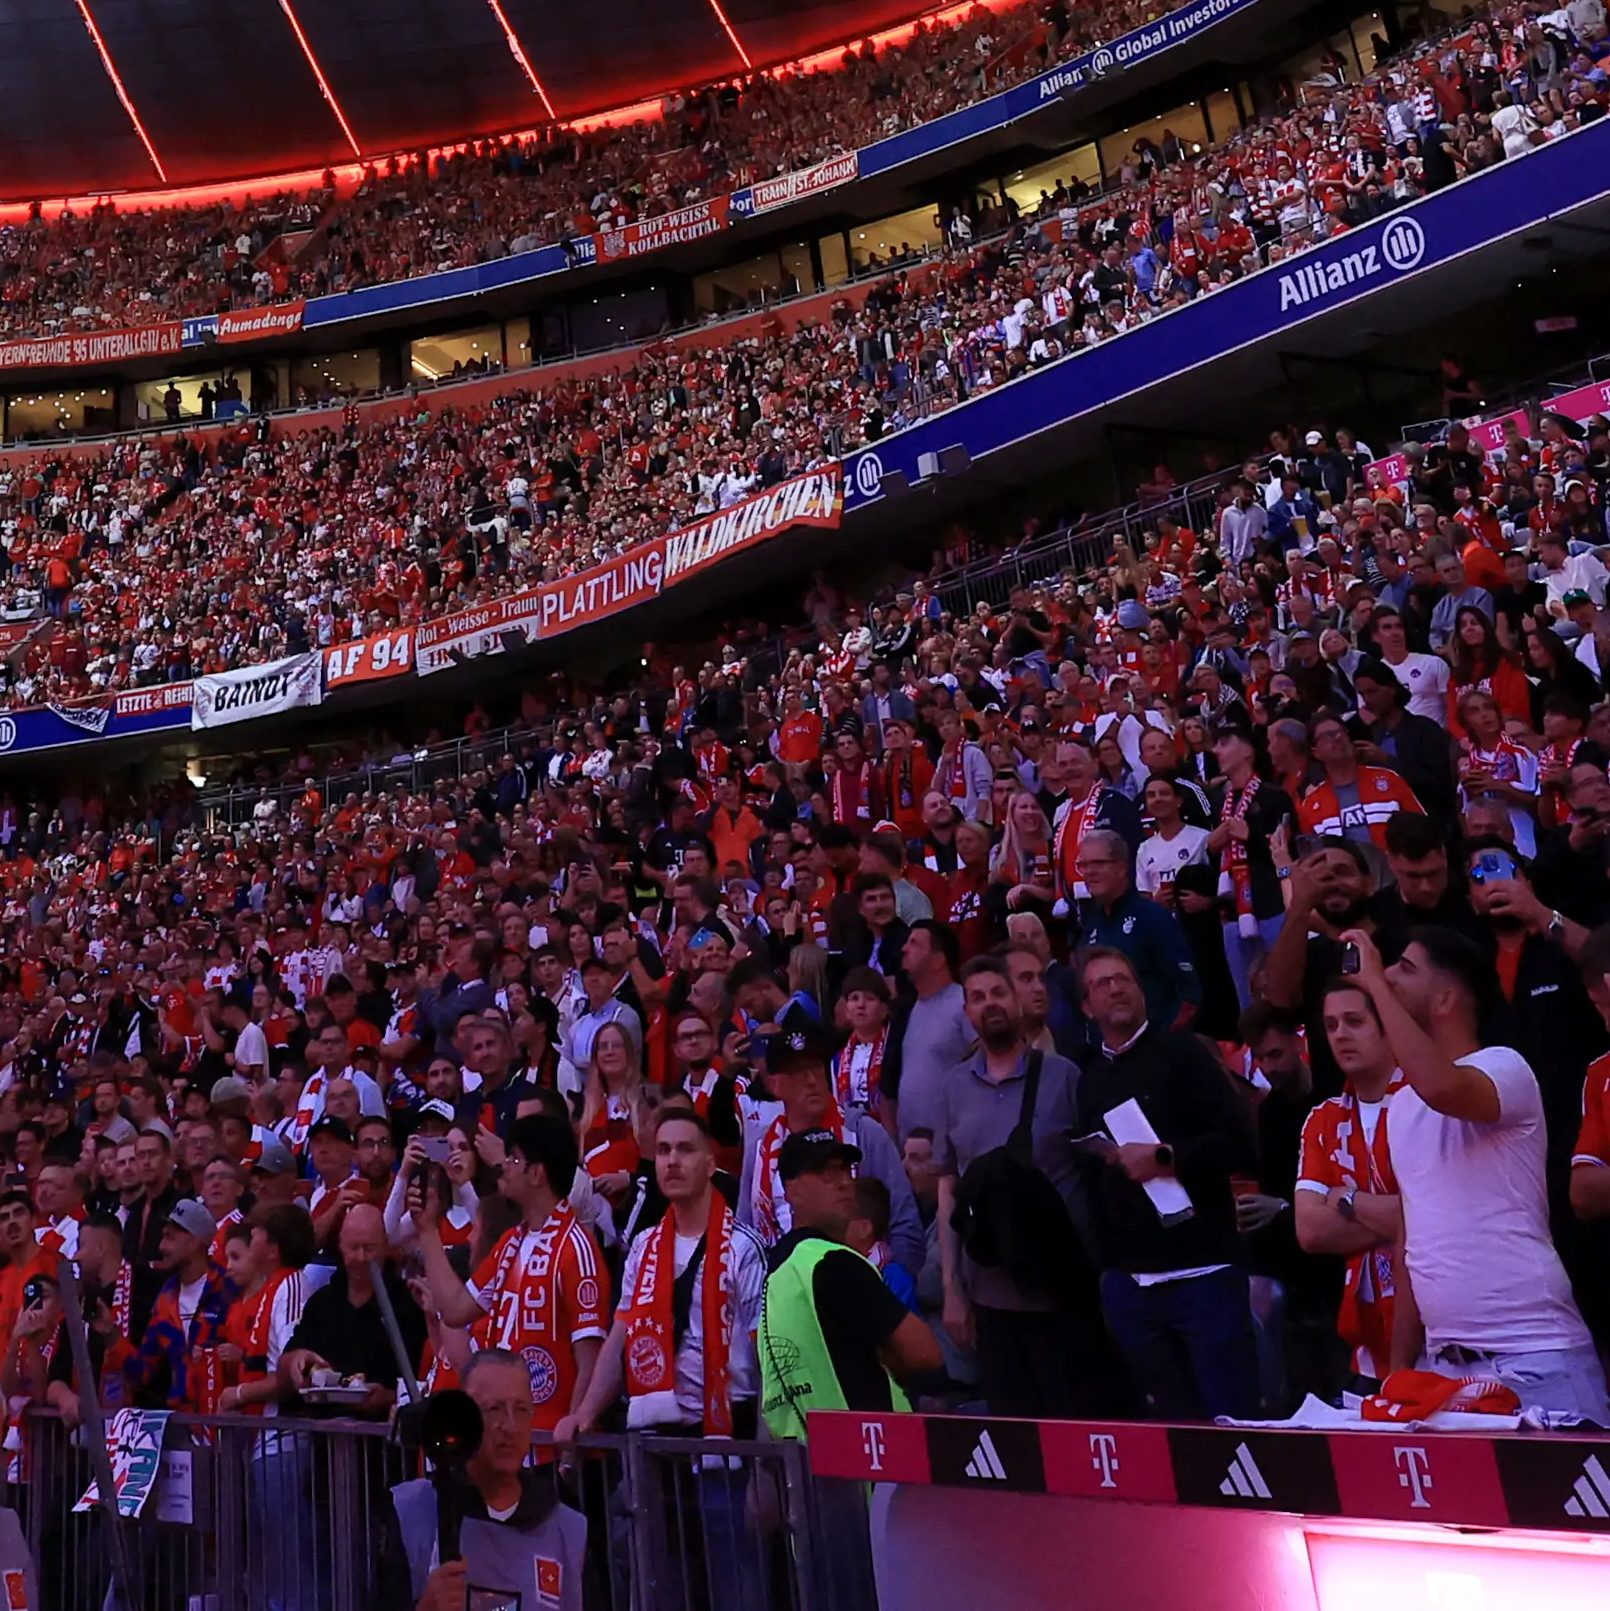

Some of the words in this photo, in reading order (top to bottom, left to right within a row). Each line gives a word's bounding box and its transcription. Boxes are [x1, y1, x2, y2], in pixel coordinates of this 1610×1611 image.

[1039, 64, 1089, 99] Allian
[1115, 24, 1167, 62] Global
[628, 217, 721, 256] KOLLBACHTAL
[638, 204, 710, 238] ROT-WEISS
[1278, 245, 1382, 312] Allianz
[1487, 423, 1502, 443] T
[1385, 460, 1398, 479] T
[541, 550, 664, 627] PLATTLING
[663, 471, 838, 580] WALDKIRCHEN
[448, 611, 490, 634] Weisse
[326, 644, 365, 682] AF
[371, 633, 409, 671] 94
[116, 693, 152, 714] LETZTE
[861, 1422, 886, 1471] T
[1088, 1433, 1120, 1489] T
[1393, 1446, 1433, 1509] T
